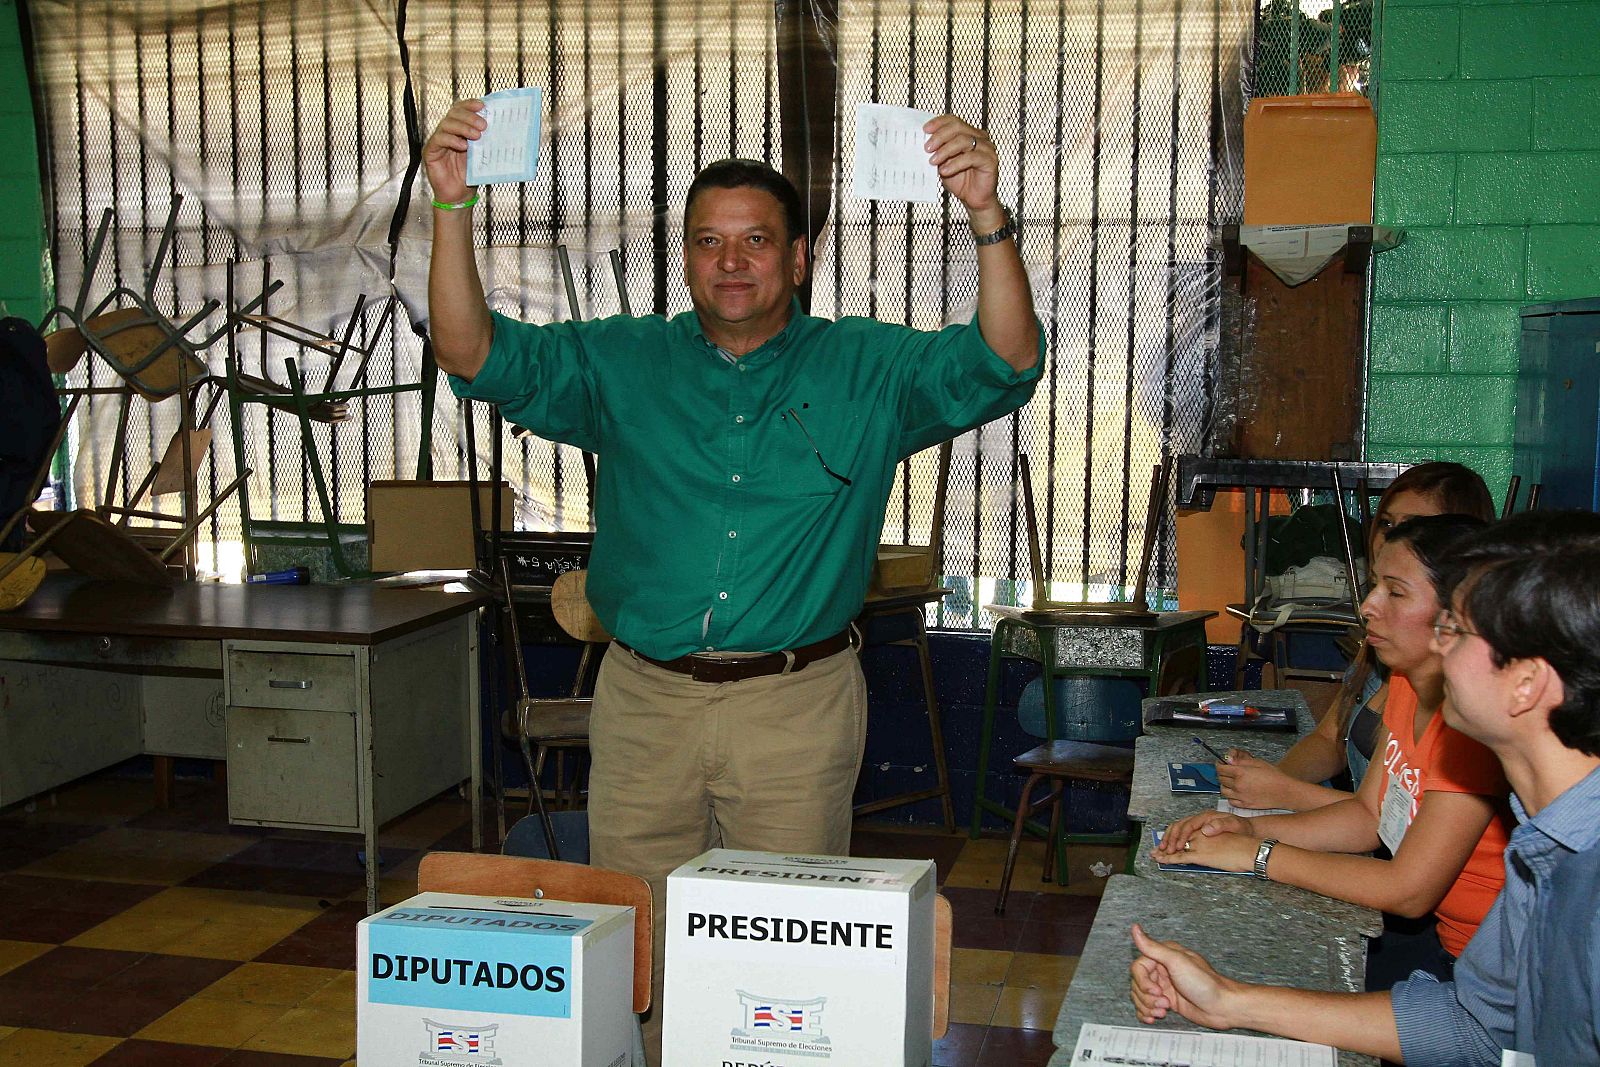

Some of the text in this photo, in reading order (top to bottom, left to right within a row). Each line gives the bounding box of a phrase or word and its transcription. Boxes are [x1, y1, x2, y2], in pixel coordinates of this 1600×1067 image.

[697, 866, 900, 886] PRESIDENTE
[384, 912, 580, 932] DIPUTADOS
[687, 912, 893, 949] PRESIDENTE
[372, 953, 566, 993] DIPUTADOS
[732, 1037, 757, 1045] Tribunal
[757, 1038, 787, 1048] Supremo
[798, 1042, 832, 1052] Elecciones
